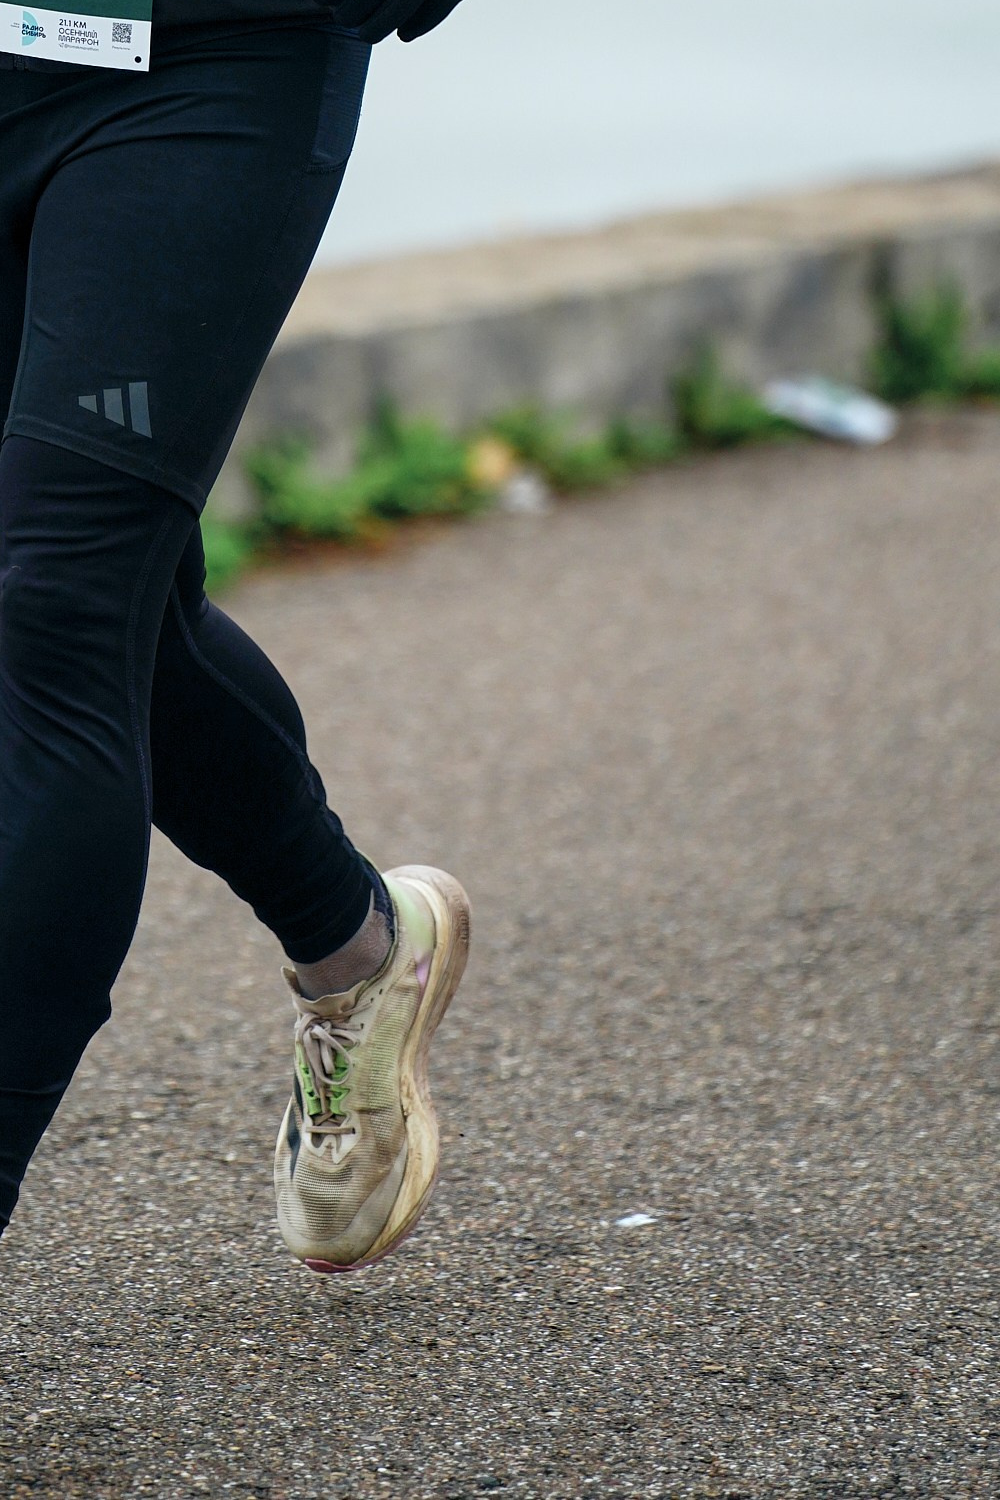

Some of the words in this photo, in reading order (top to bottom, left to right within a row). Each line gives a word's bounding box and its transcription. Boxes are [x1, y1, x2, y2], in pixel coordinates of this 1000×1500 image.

[22, 23, 44, 32] РАДИО
[58, 18, 72, 27] 21.1
[73, 20, 87, 29] КМ
[21, 29, 47, 38] СИБИРЬ
[58, 27, 98, 39] ОСЕННИЙ
[58, 34, 99, 46] МАРАФОН
